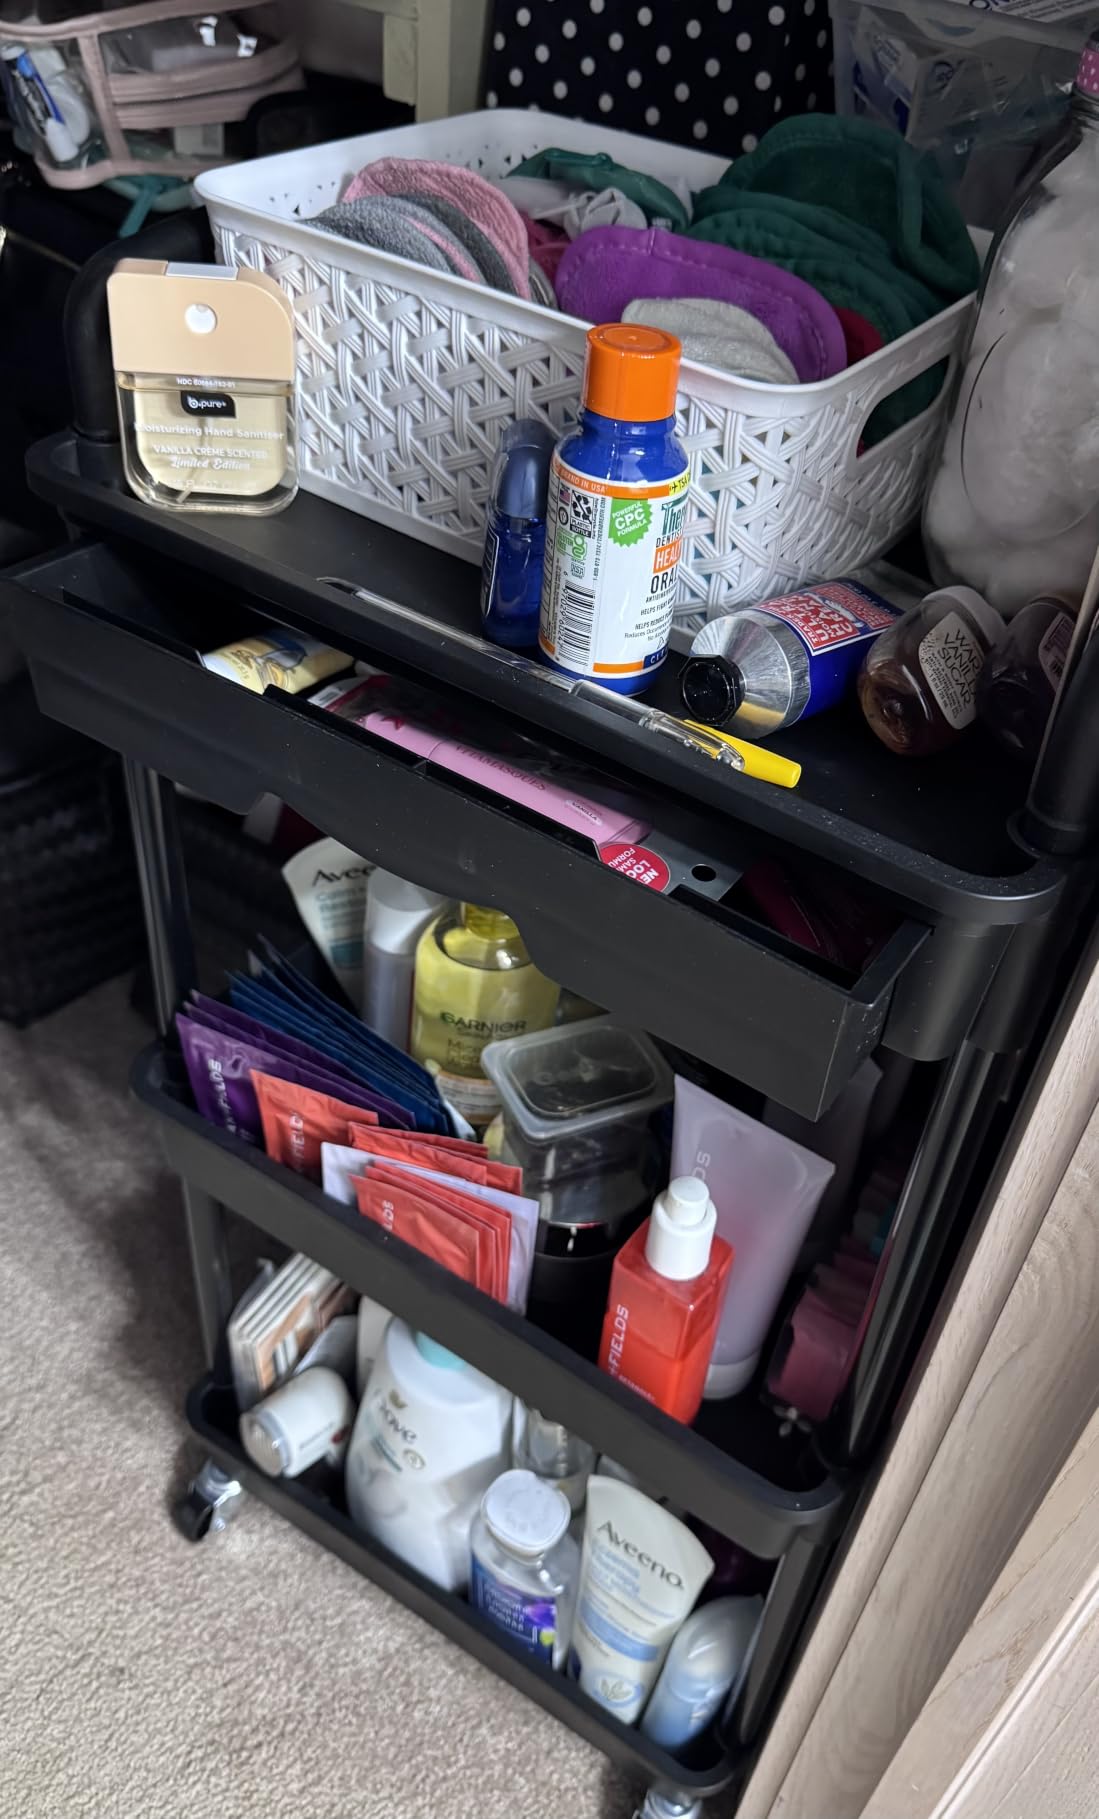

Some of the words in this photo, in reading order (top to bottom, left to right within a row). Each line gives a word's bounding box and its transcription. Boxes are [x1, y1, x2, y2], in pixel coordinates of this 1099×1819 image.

[204, 426, 233, 438] Hand
[152, 444, 193, 455] VANILLA
[227, 449, 269, 459] SCENTED
[169, 456, 209, 469] Limited
[213, 457, 251, 470] Edition
[580, 480, 589, 489] IN
[612, 503, 643, 517] POWERFUL
[615, 508, 645, 529] CPC
[616, 519, 648, 537] FORMULA
[635, 621, 650, 630] HELPS
[937, 646, 971, 706] SUGAR
[455, 745, 547, 791] VITAMASQUES
[571, 801, 599, 821] VANILLA
[639, 868, 659, 885] NE
[440, 1011, 528, 1033] GARNIER
[597, 1519, 686, 1591] Aveeno
